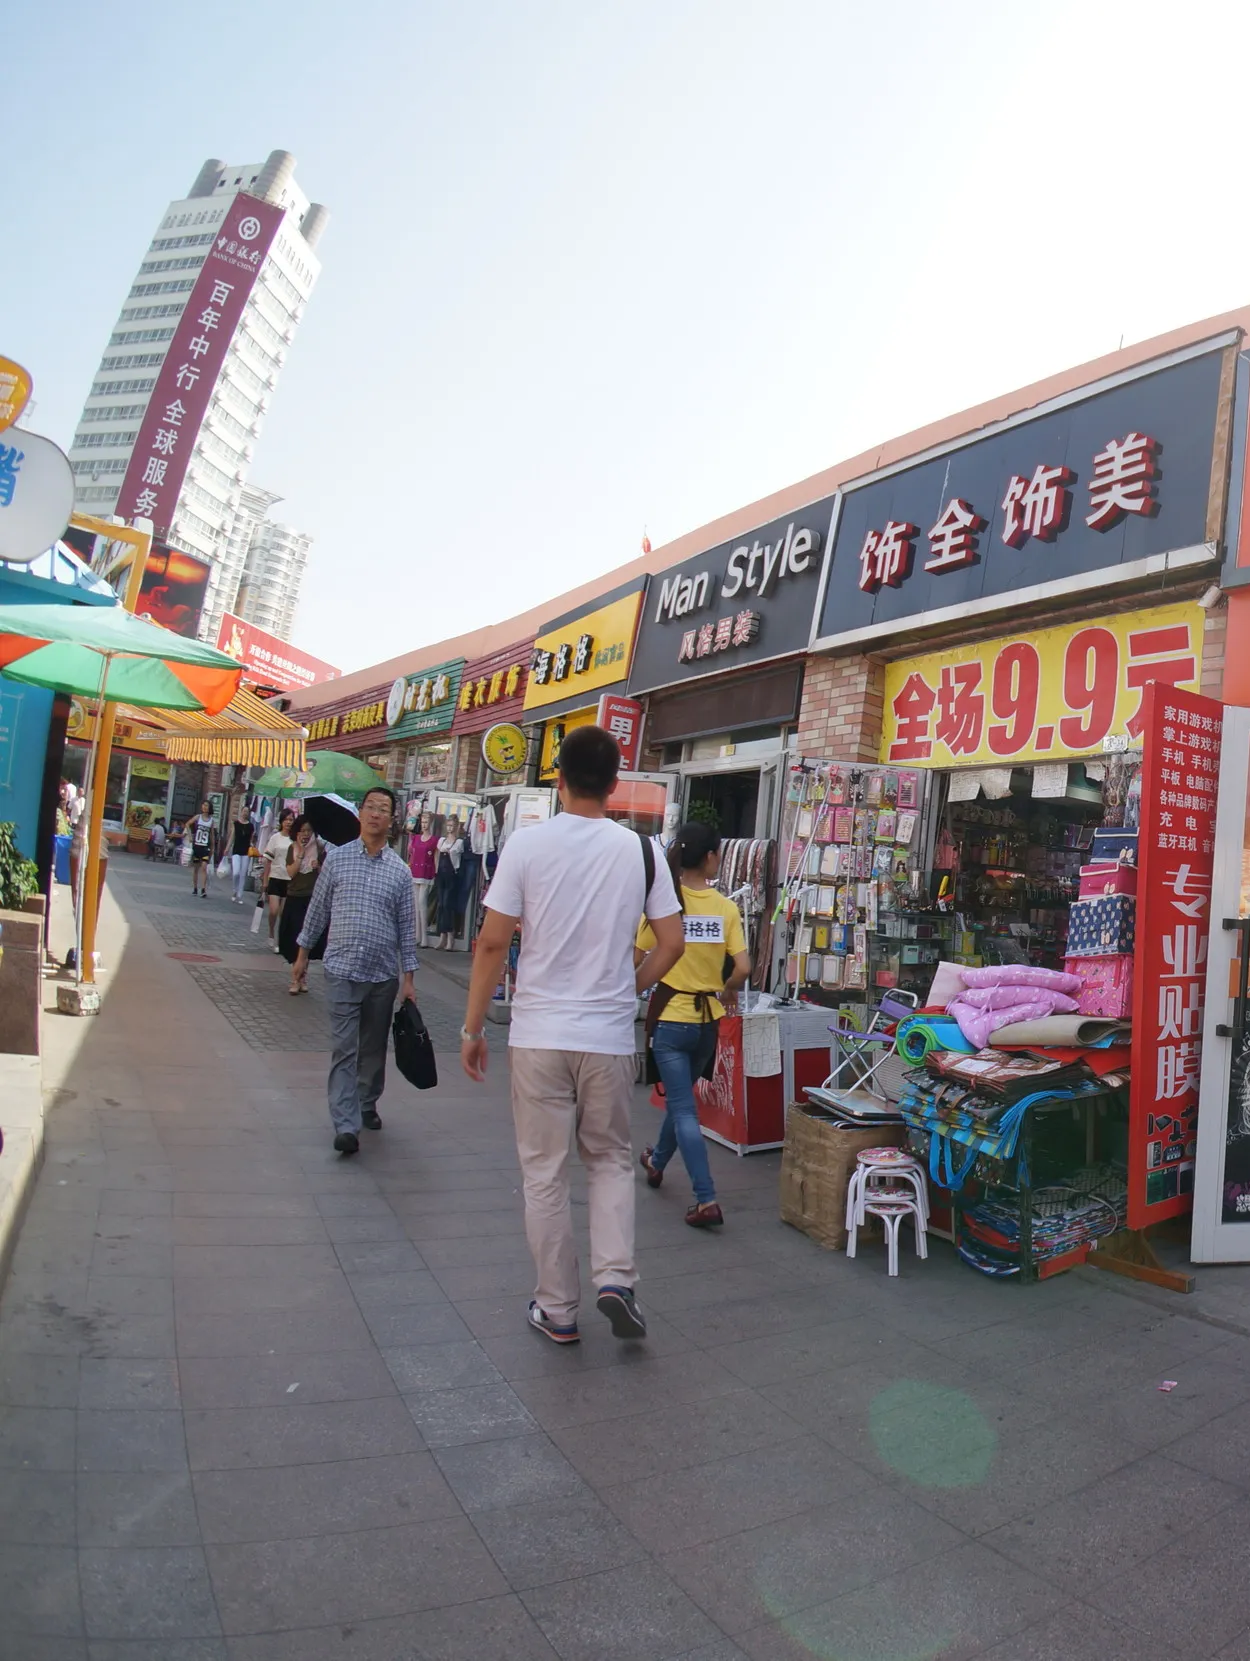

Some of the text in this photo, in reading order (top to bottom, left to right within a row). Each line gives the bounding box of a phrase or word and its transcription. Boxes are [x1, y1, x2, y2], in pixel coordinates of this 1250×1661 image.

[212, 251, 228, 262] BANK
[236, 260, 256, 273] CHINA
[217, 236, 261, 265] 中国银行
[133, 279, 234, 517] 百年中行 全球服务
[858, 432, 1153, 593] 饰全饰美
[655, 522, 816, 624] Man Style
[677, 608, 756, 664] 风格男装
[888, 624, 1196, 762] 全场9.9元
[1163, 704, 1222, 735] 家用游戏机
[1162, 725, 1222, 754] 掌上游戏机
[1161, 747, 1185, 766] 手机
[1160, 768, 1181, 786] 平板
[1159, 788, 1219, 813] 各种品牌数码产
[1157, 832, 1198, 852] 蓝牙耳机
[1154, 863, 1211, 1101] 专业贴膜
